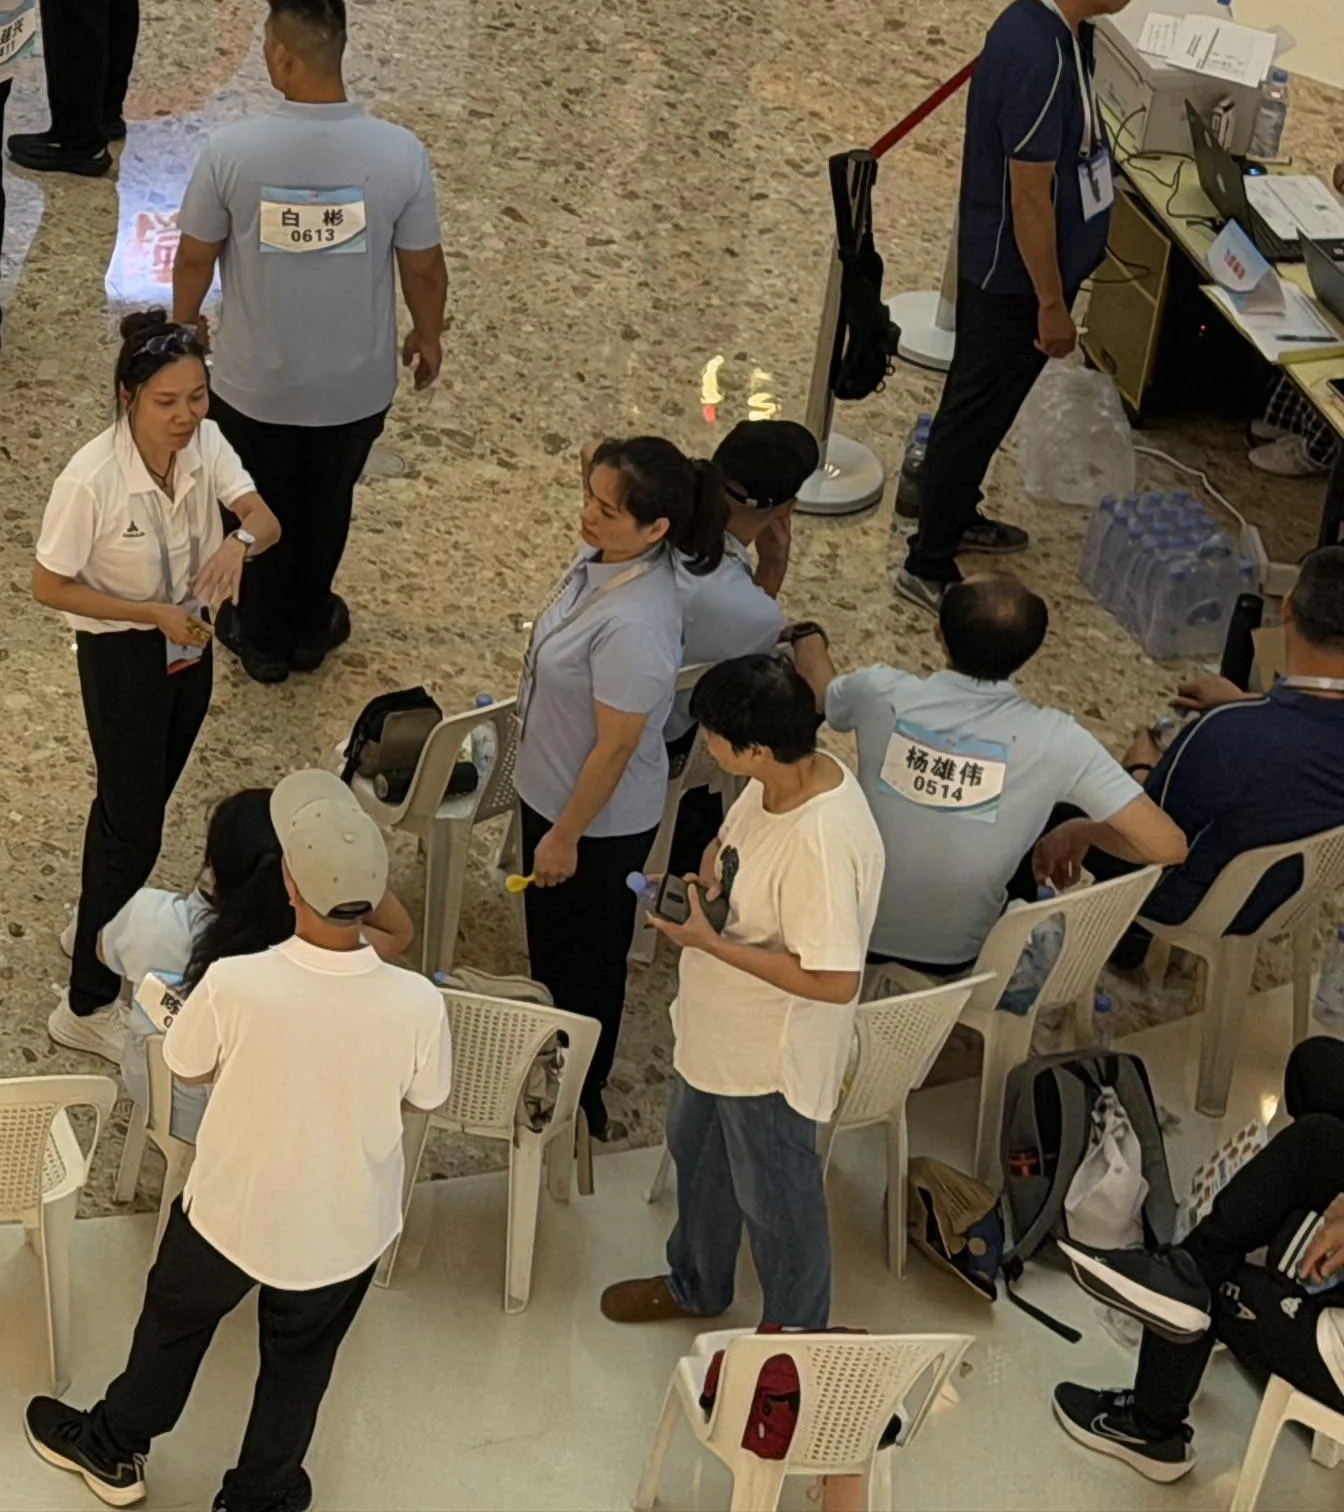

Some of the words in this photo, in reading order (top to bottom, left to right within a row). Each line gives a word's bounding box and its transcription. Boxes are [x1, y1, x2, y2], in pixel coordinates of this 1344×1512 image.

[281, 207, 344, 228] 白彬
[290, 228, 335, 243] 0613
[905, 745, 985, 787] 杨雄伟
[913, 775, 964, 802] 0514
